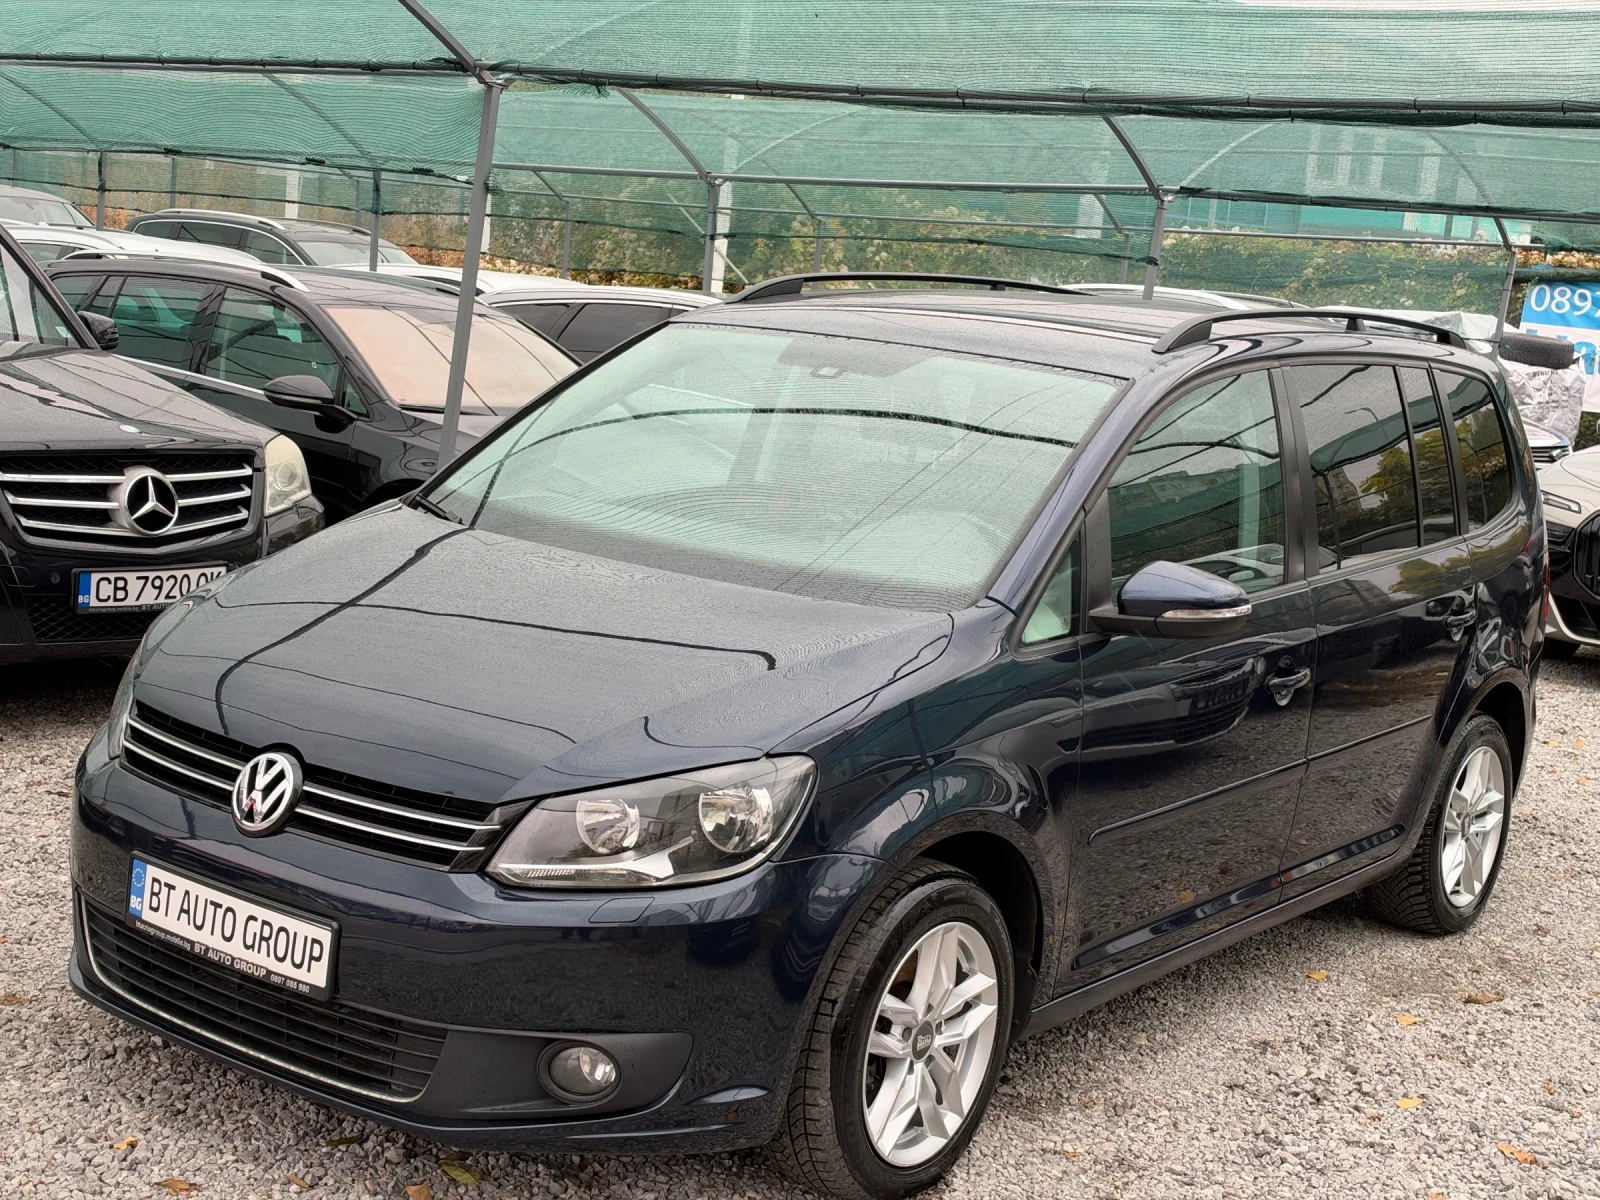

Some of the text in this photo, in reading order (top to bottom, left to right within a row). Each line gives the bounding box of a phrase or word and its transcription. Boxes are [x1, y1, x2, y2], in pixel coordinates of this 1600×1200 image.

[78, 594, 90, 604] BG
[95, 576, 129, 603] CB
[135, 574, 191, 602] 7920
[233, 753, 295, 831] VW
[130, 895, 142, 911] BG
[149, 876, 324, 974] BT AUTO GROUP
[135, 919, 191, 951] btautogroup.mobile.bg
[194, 943, 206, 955] BT
[207, 948, 232, 966] AUTO
[234, 959, 267, 978] GROUP
